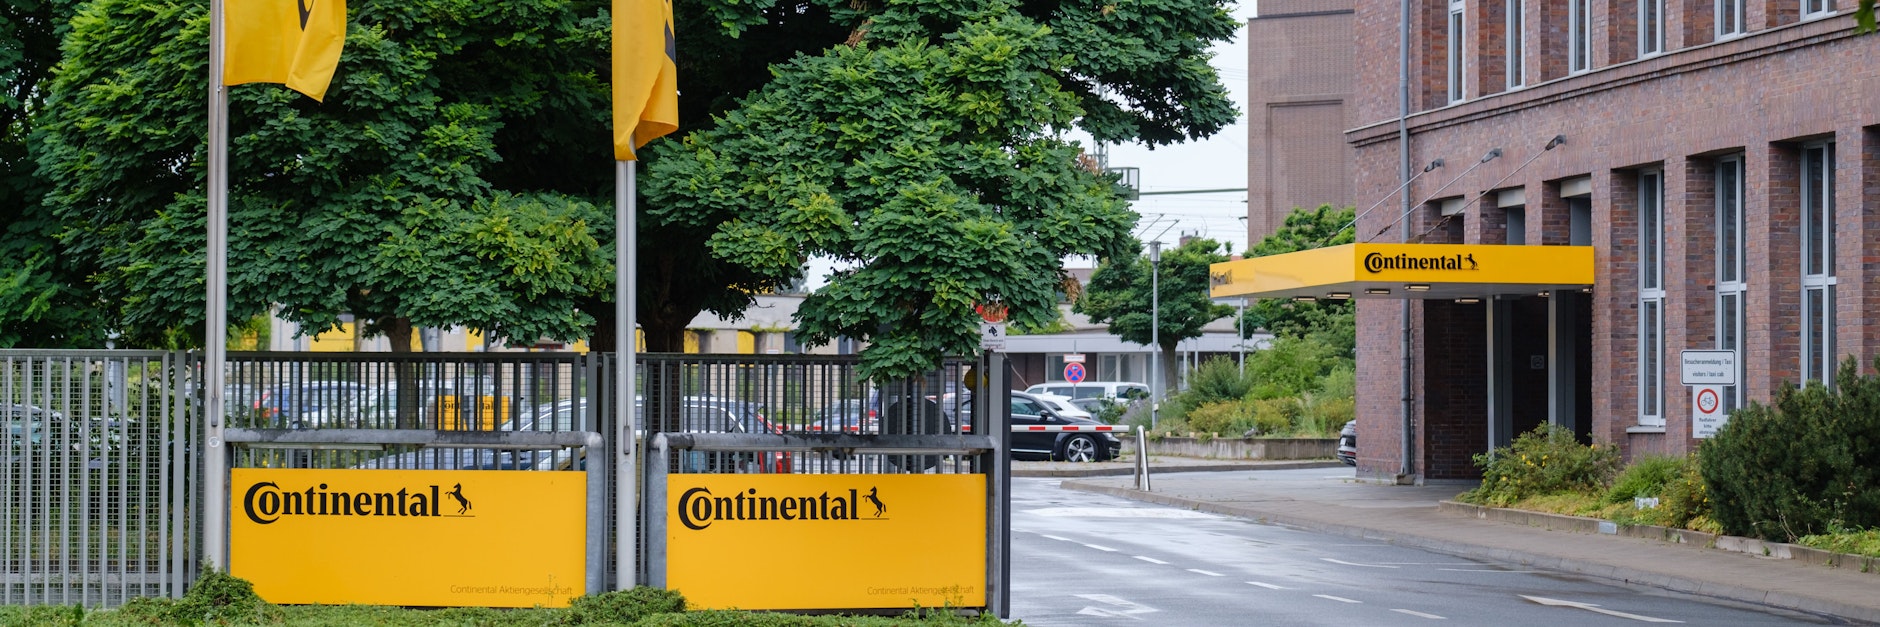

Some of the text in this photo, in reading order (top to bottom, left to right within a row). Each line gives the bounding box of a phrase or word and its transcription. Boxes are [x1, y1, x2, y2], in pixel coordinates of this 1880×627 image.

[1364, 252, 1462, 273] Continental
[244, 481, 441, 525] Continental
[678, 486, 860, 531] Continental
[450, 584, 496, 593] Continental
[867, 586, 974, 597] Continental Aktiengeellchaft
